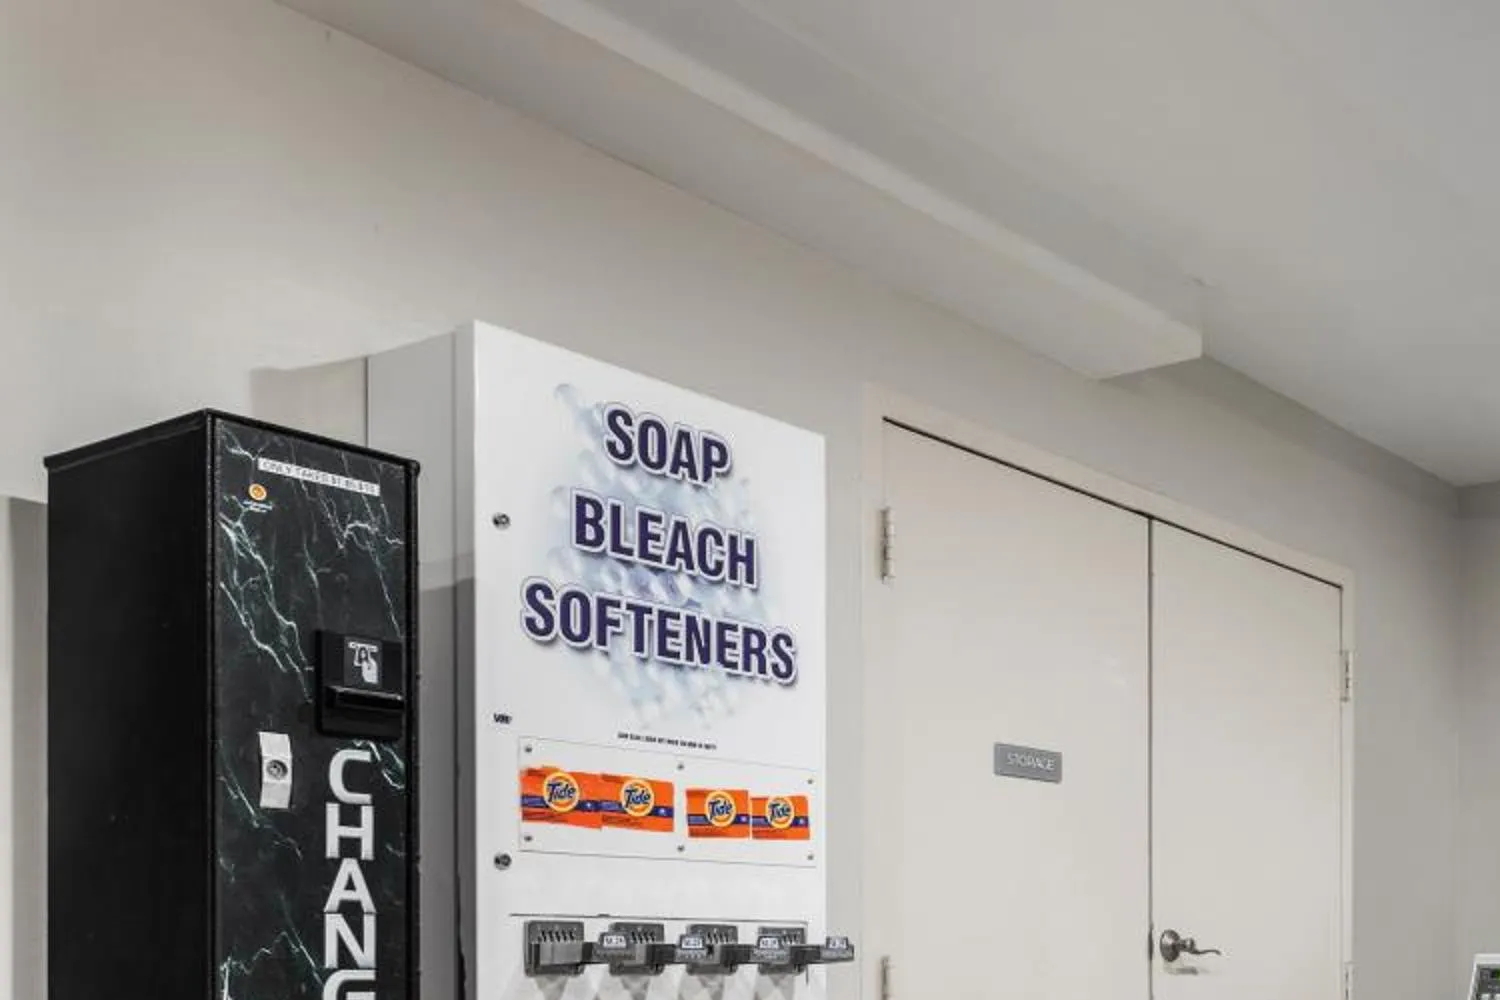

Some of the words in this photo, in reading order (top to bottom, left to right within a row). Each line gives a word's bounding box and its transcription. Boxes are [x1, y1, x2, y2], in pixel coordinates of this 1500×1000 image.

[603, 403, 732, 485] SOAP
[572, 490, 758, 588] BLEACH
[522, 579, 796, 682] SOFTENERS
[547, 781, 577, 803] Tide
[625, 788, 652, 808] Tide
